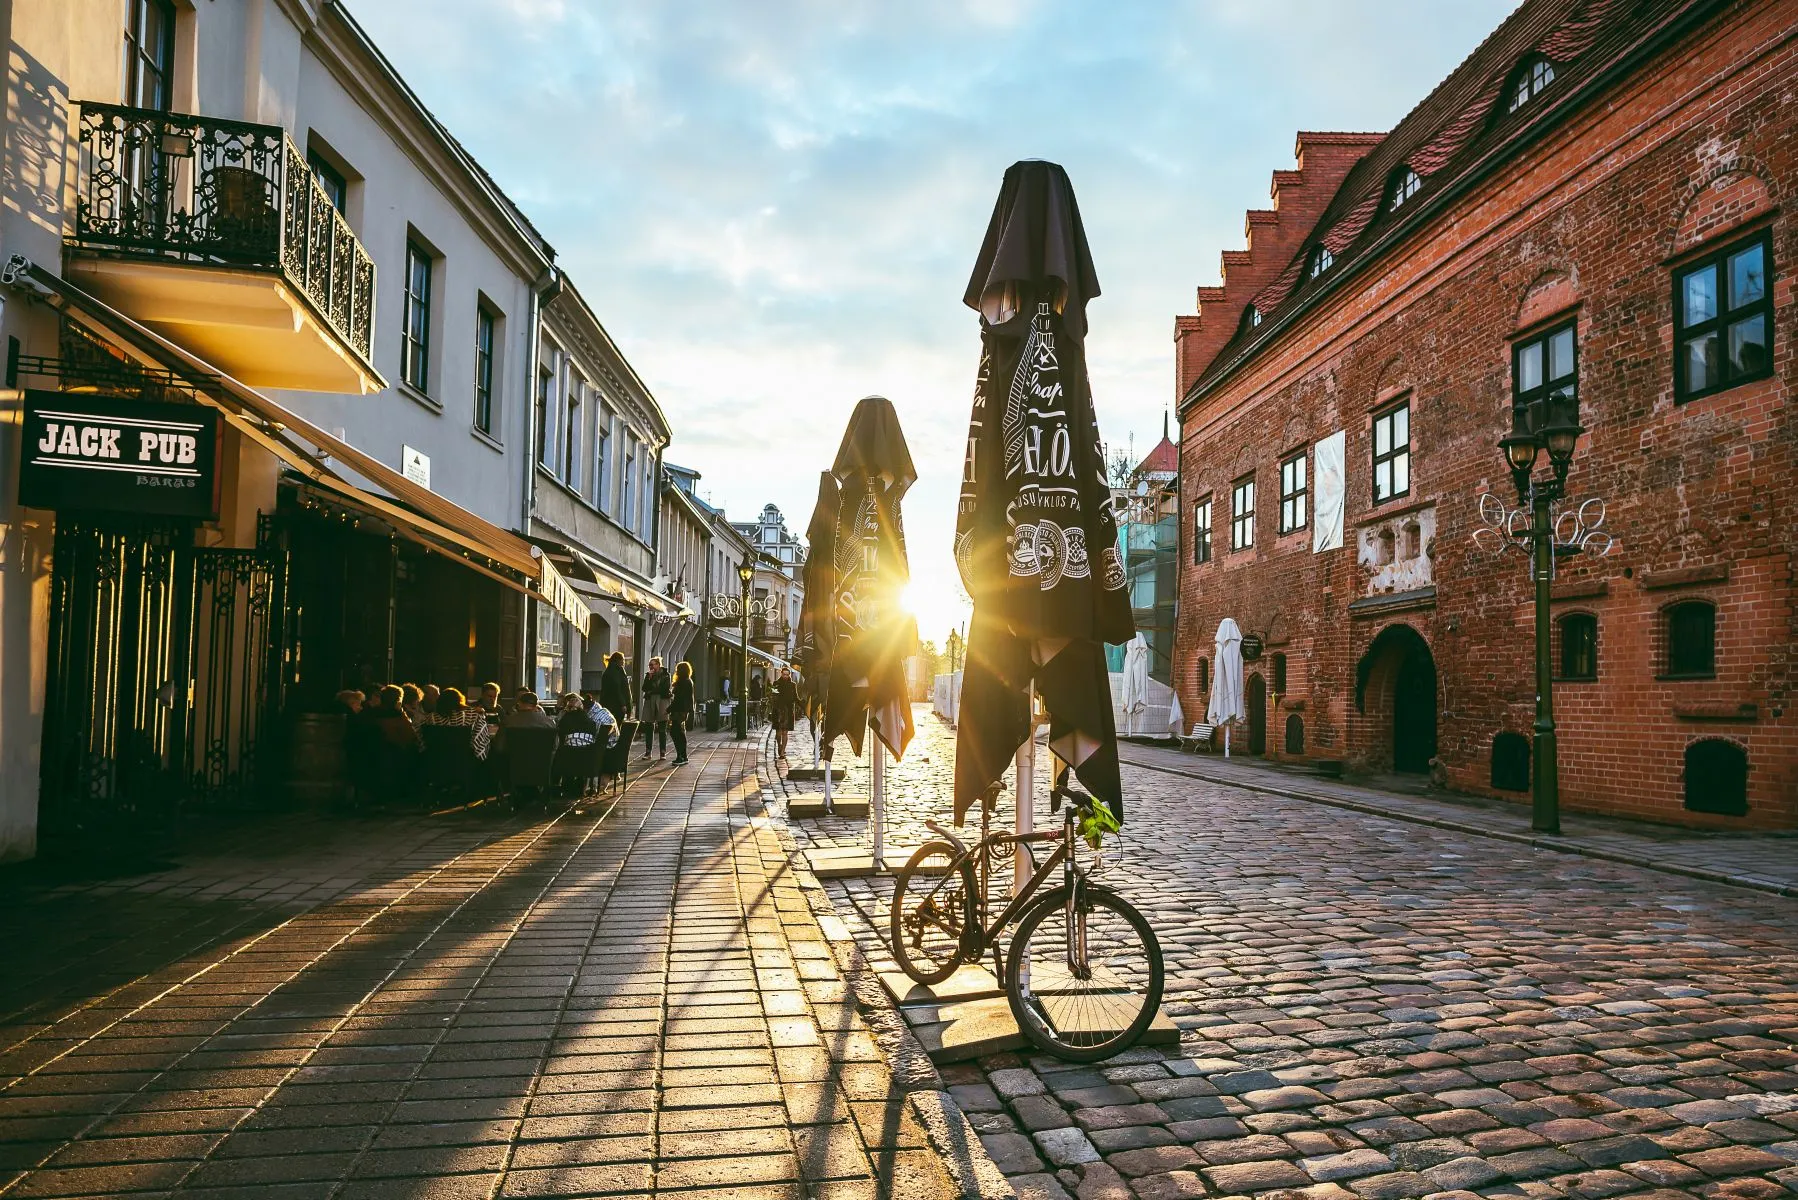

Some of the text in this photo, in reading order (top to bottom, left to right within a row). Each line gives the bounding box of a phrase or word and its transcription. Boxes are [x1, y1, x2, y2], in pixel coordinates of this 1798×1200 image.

[38, 423, 196, 464] JACK PUB
[136, 475, 196, 488] BARAS
